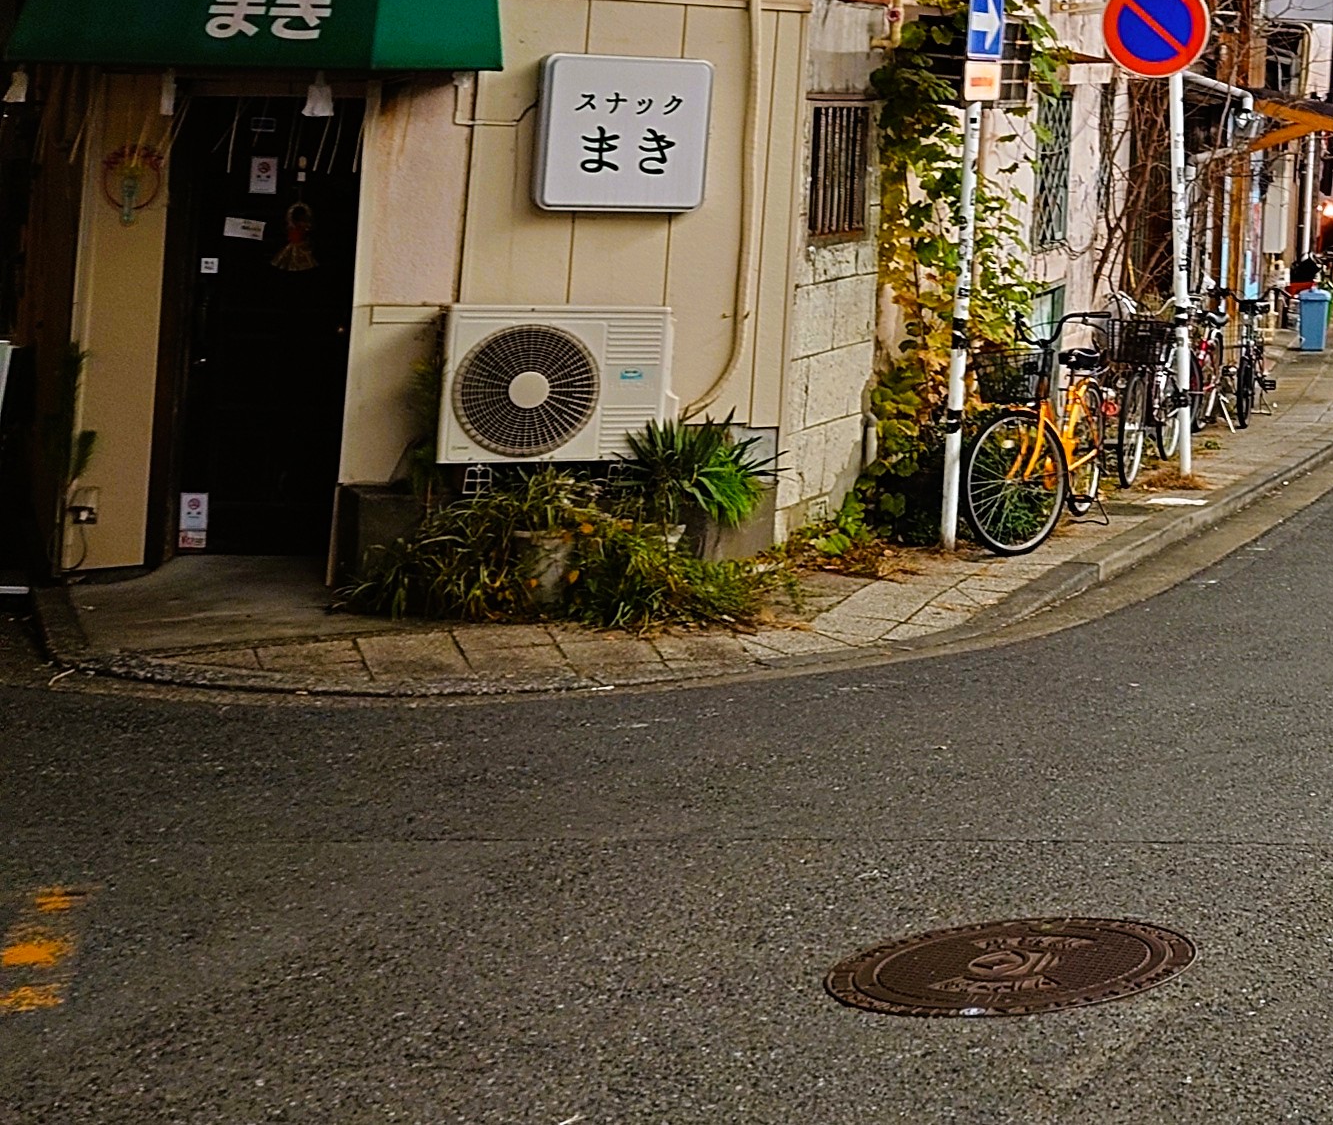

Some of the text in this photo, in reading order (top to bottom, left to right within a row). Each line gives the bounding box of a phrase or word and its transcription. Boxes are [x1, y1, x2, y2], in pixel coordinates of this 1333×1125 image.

[574, 91, 685, 117] スナック
[579, 126, 677, 175] まき
